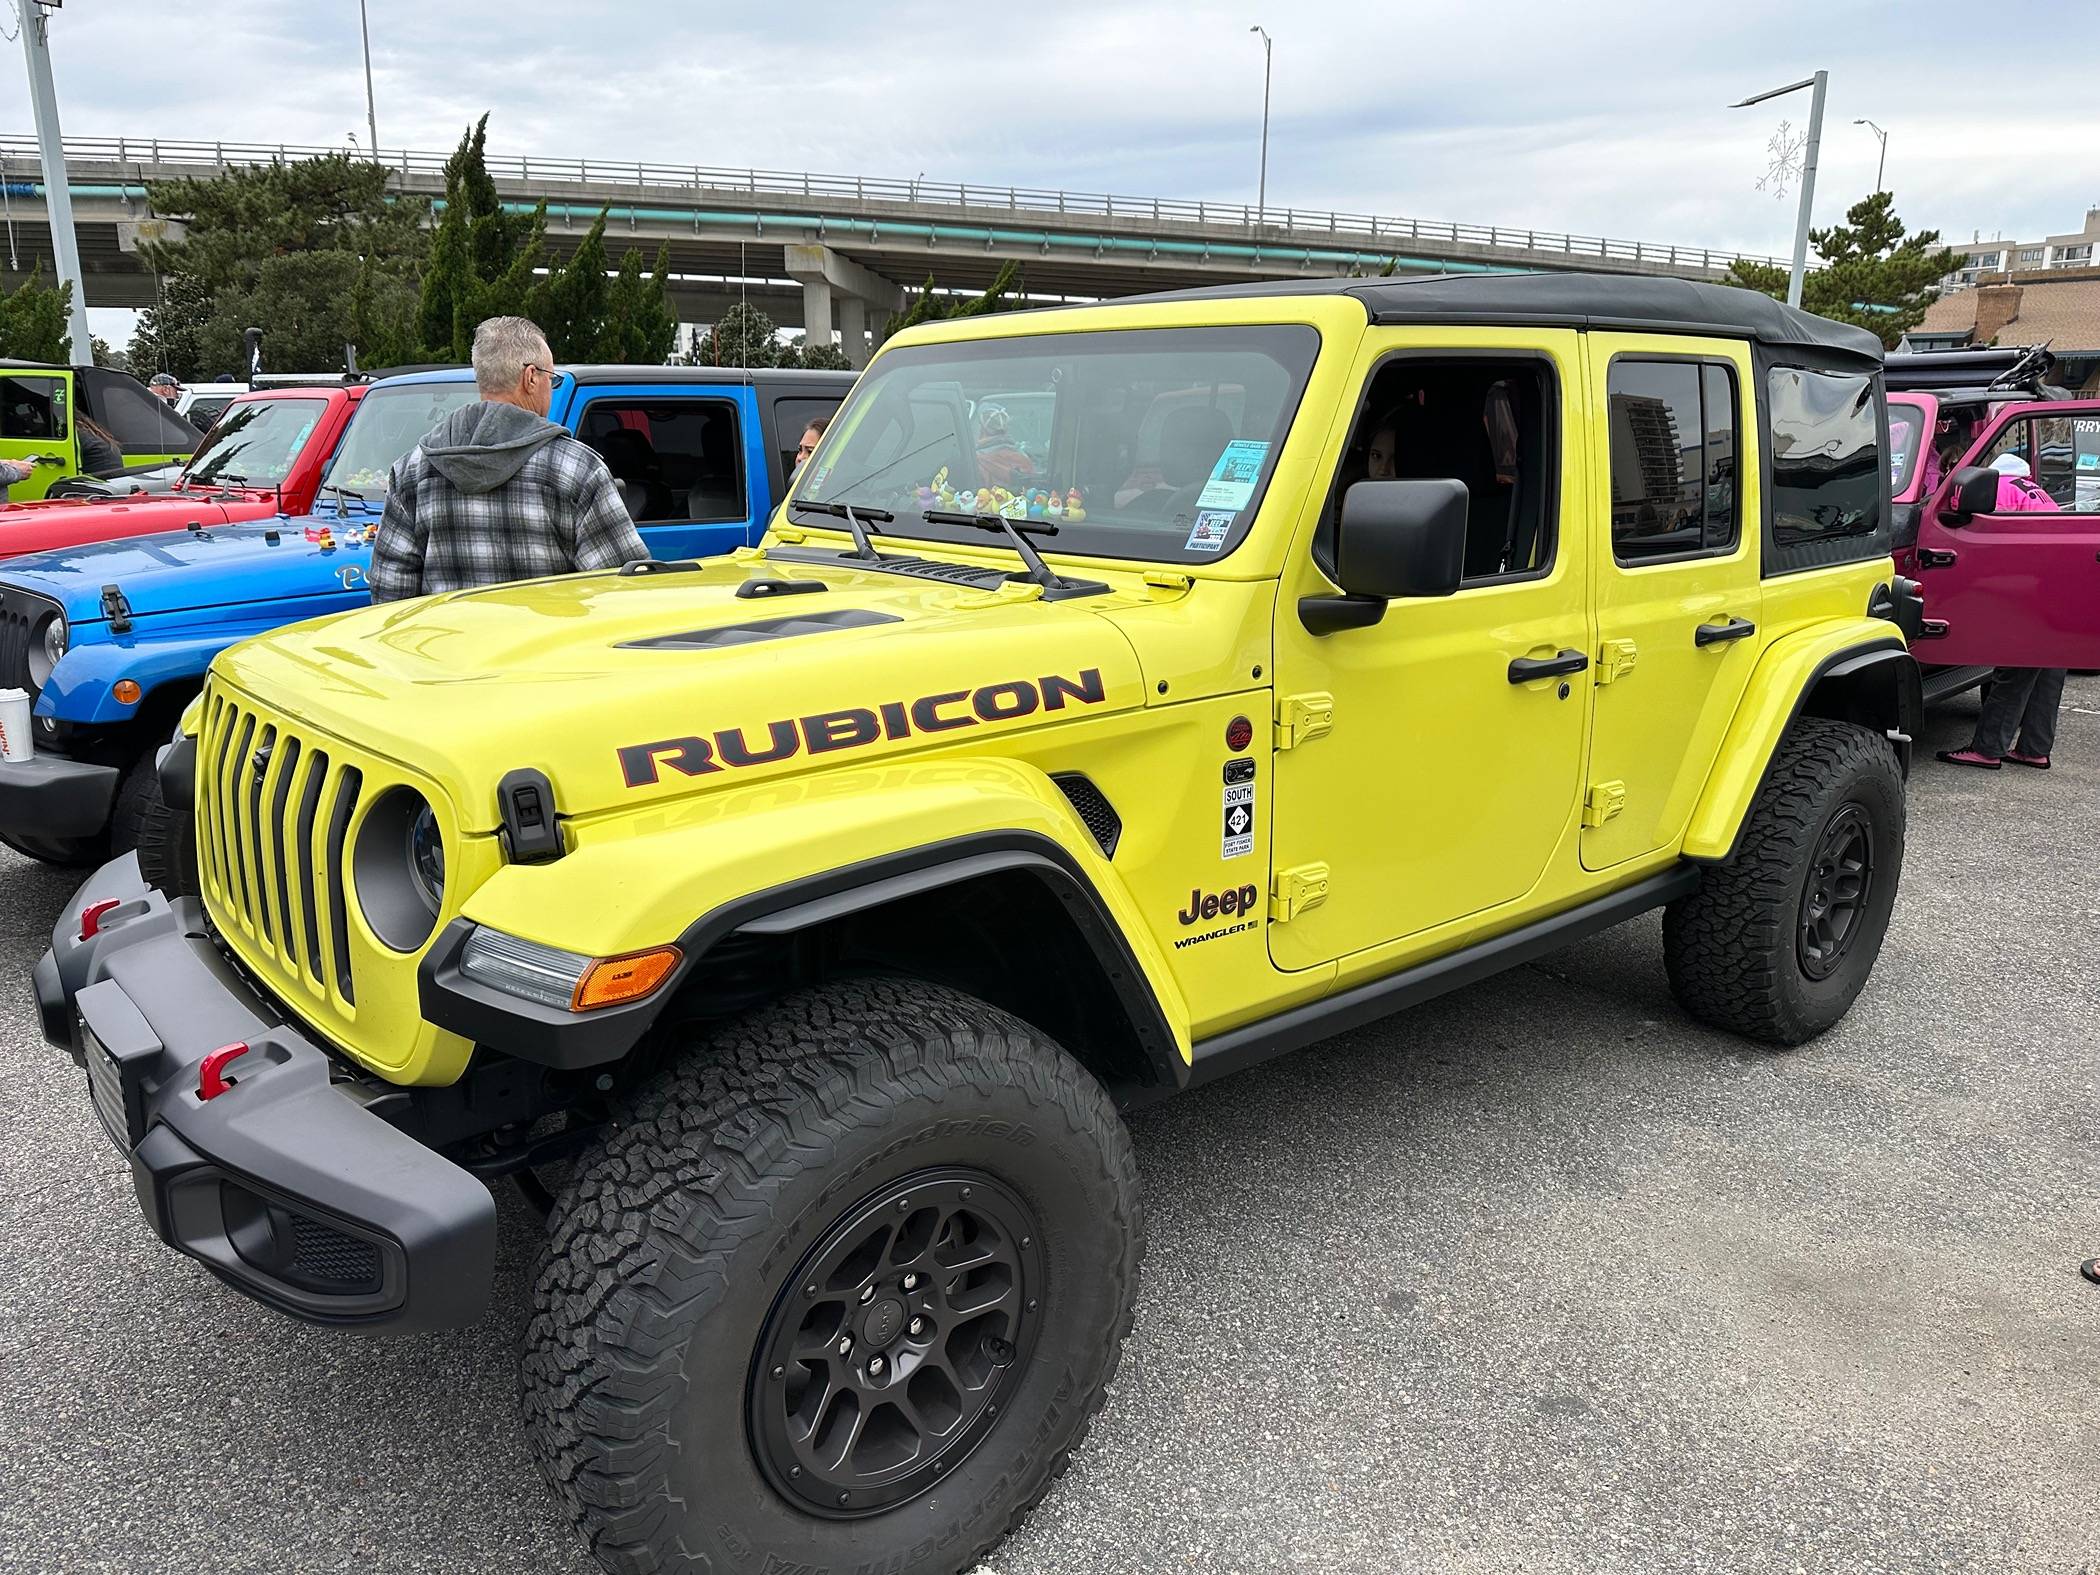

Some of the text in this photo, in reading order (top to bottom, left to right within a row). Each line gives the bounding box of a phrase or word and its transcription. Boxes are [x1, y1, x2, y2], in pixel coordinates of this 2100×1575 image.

[616, 668, 1106, 788] RUBICON
[1226, 786, 1252, 802] SOUTH
[1230, 814, 1246, 826] 421
[1178, 883, 1257, 925] Jeep
[1174, 923, 1246, 949] WRANGLER
